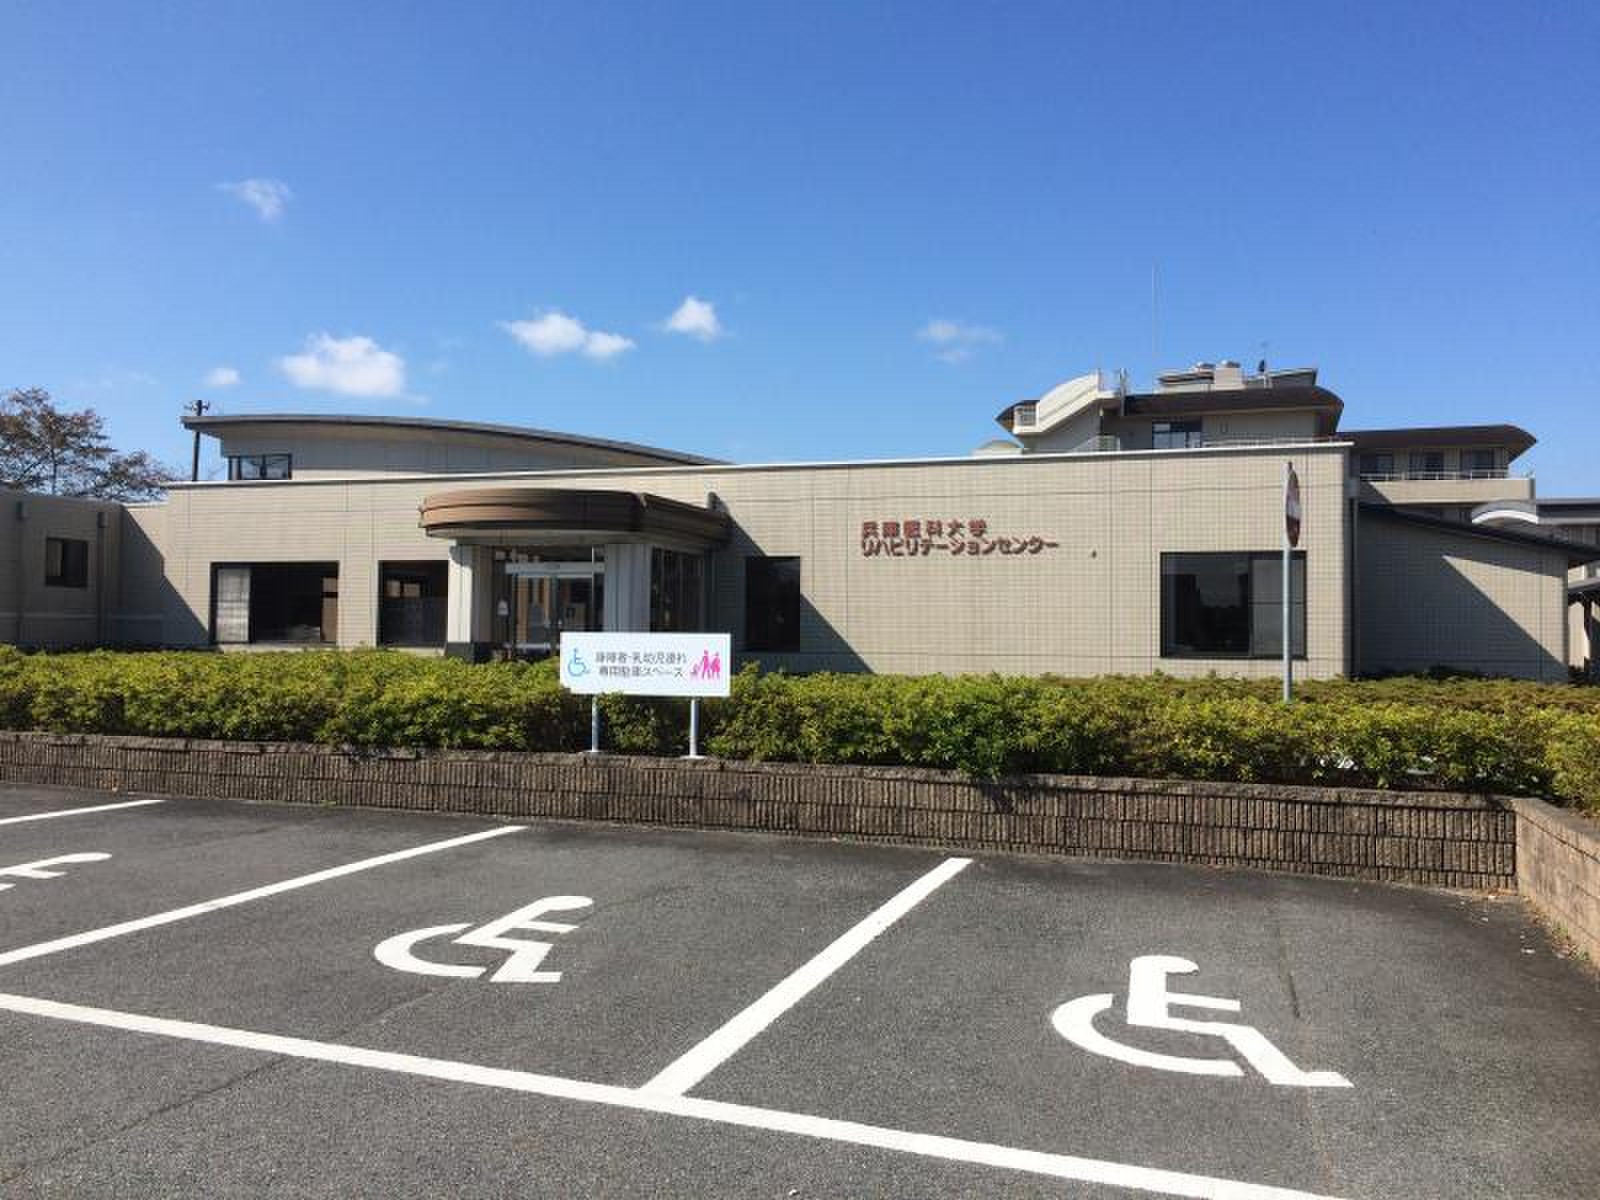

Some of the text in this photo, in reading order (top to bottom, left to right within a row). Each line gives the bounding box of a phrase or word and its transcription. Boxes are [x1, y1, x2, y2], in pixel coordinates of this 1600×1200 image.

[862, 537, 1060, 557] リハビリテーションセンター
